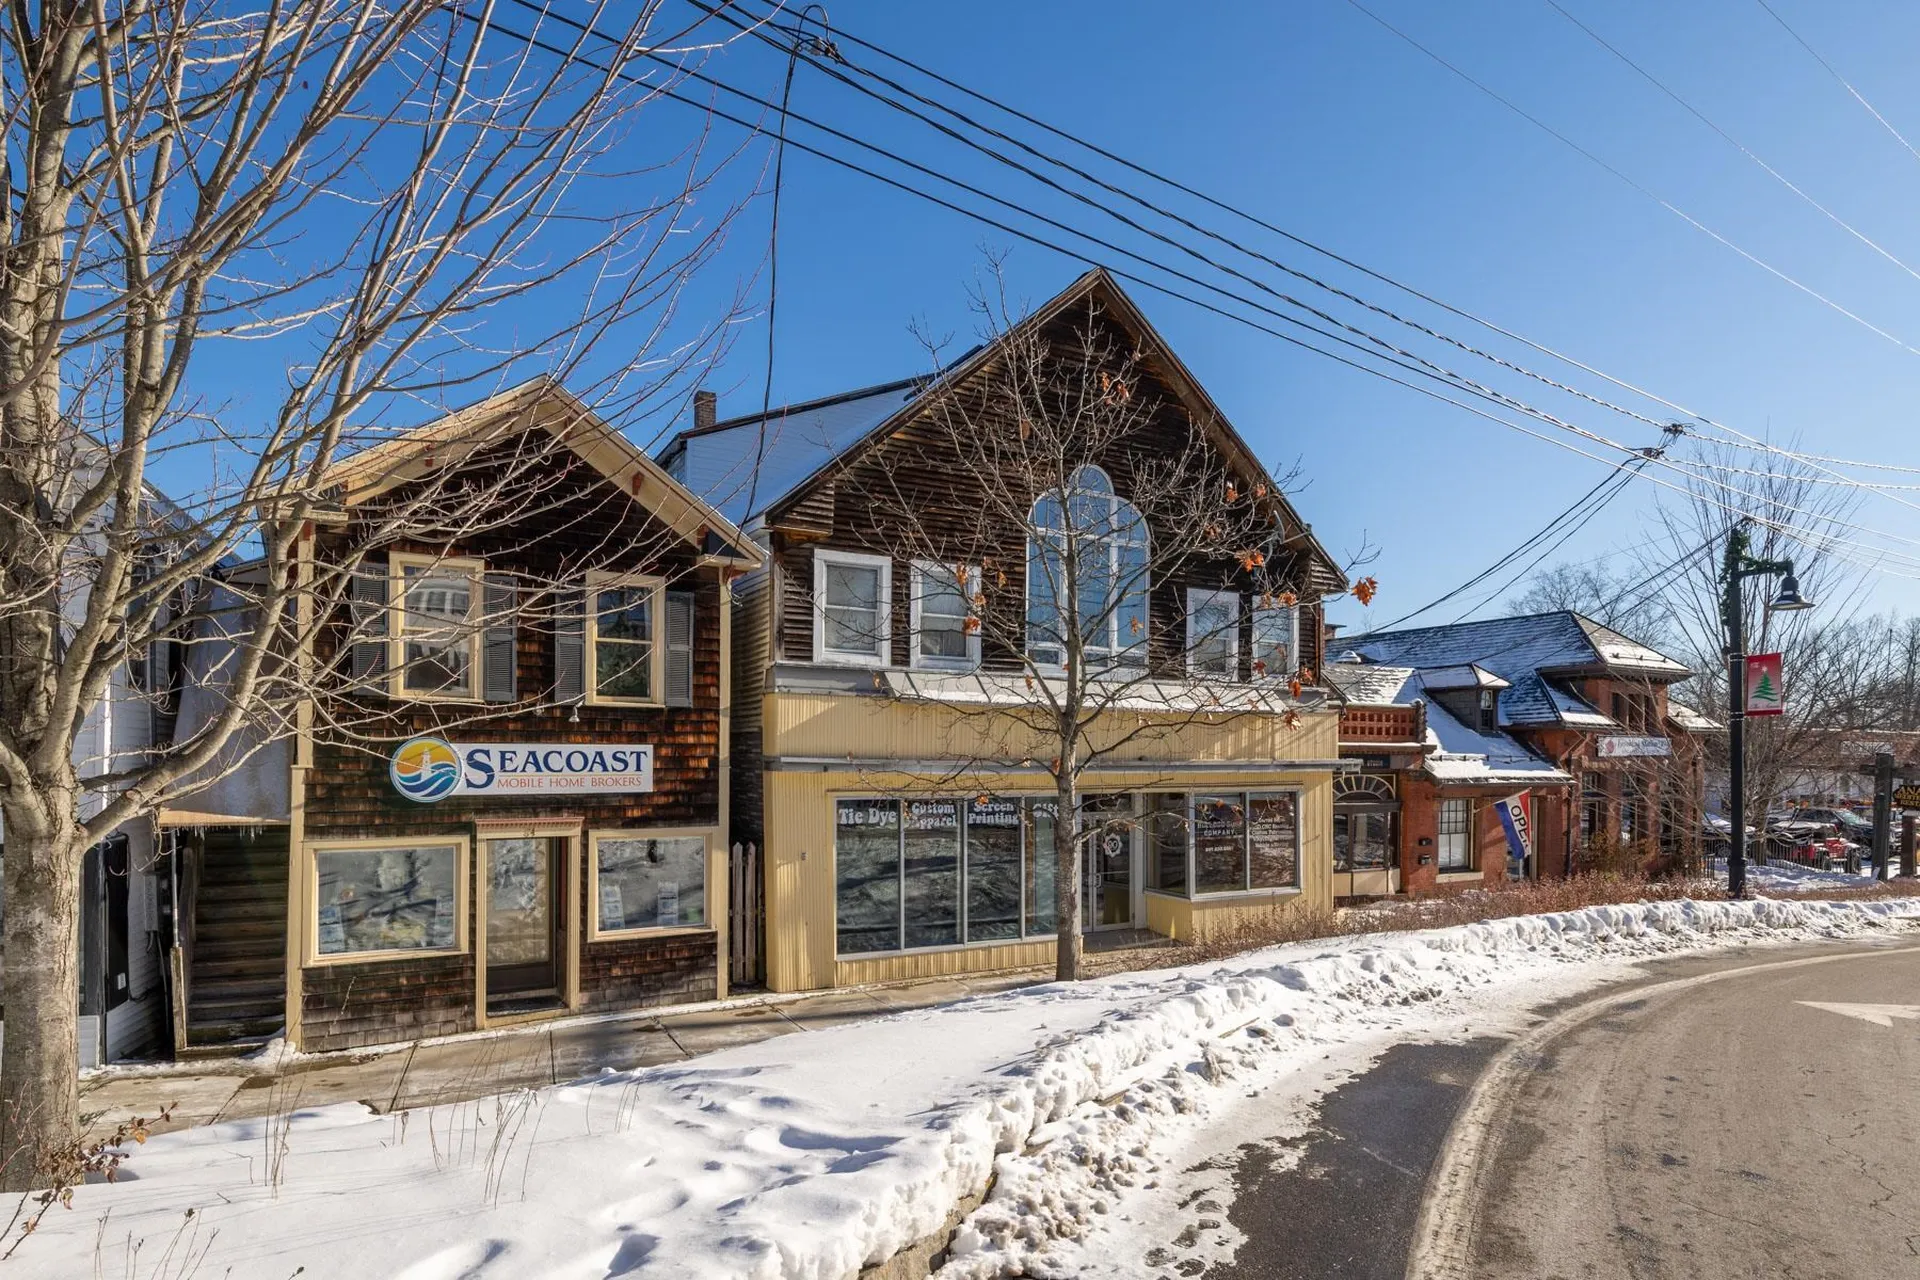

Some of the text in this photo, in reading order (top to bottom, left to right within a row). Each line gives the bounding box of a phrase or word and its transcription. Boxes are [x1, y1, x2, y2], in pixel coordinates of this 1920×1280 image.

[466, 748, 648, 790] SEACOAST
[497, 775, 641, 789] MOBILE HOME BROKERS
[911, 802, 955, 814] Custom
[973, 801, 1015, 813] Screen
[838, 807, 897, 827] Tie Dye
[967, 812, 1020, 827] Printing
